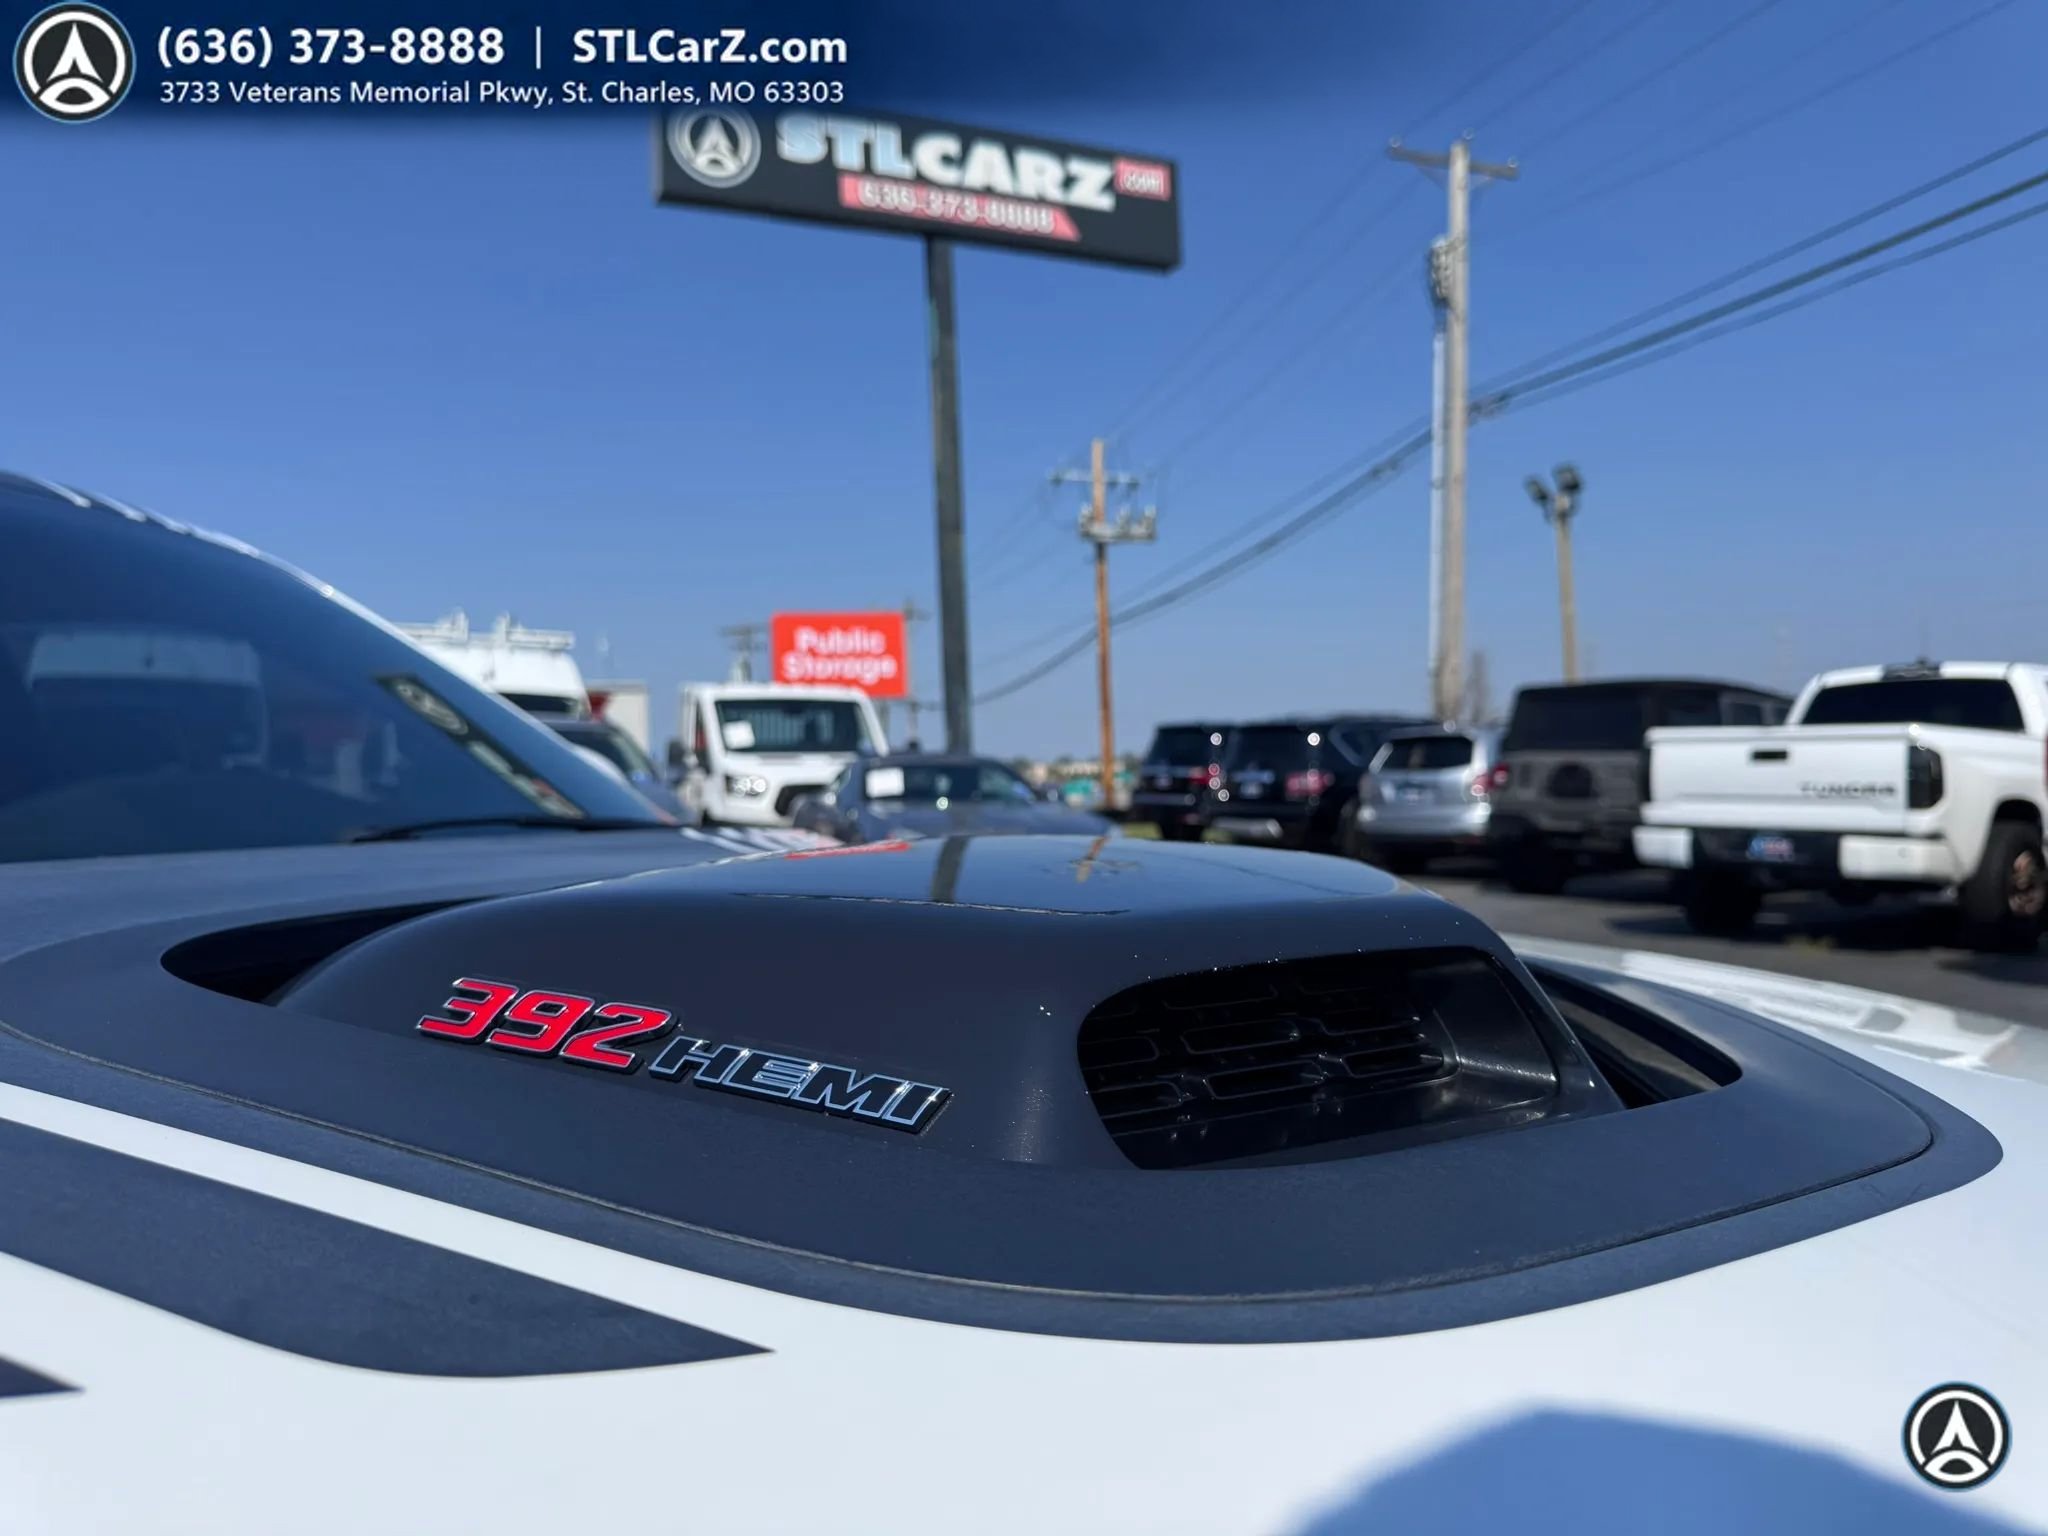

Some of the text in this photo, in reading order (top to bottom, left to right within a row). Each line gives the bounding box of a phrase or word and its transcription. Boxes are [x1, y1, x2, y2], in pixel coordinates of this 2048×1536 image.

[776, 113, 1115, 212] STLCARZ
[783, 650, 898, 686] Storage
[794, 625, 886, 655] Public
[416, 977, 953, 1133] 392 HEMI
